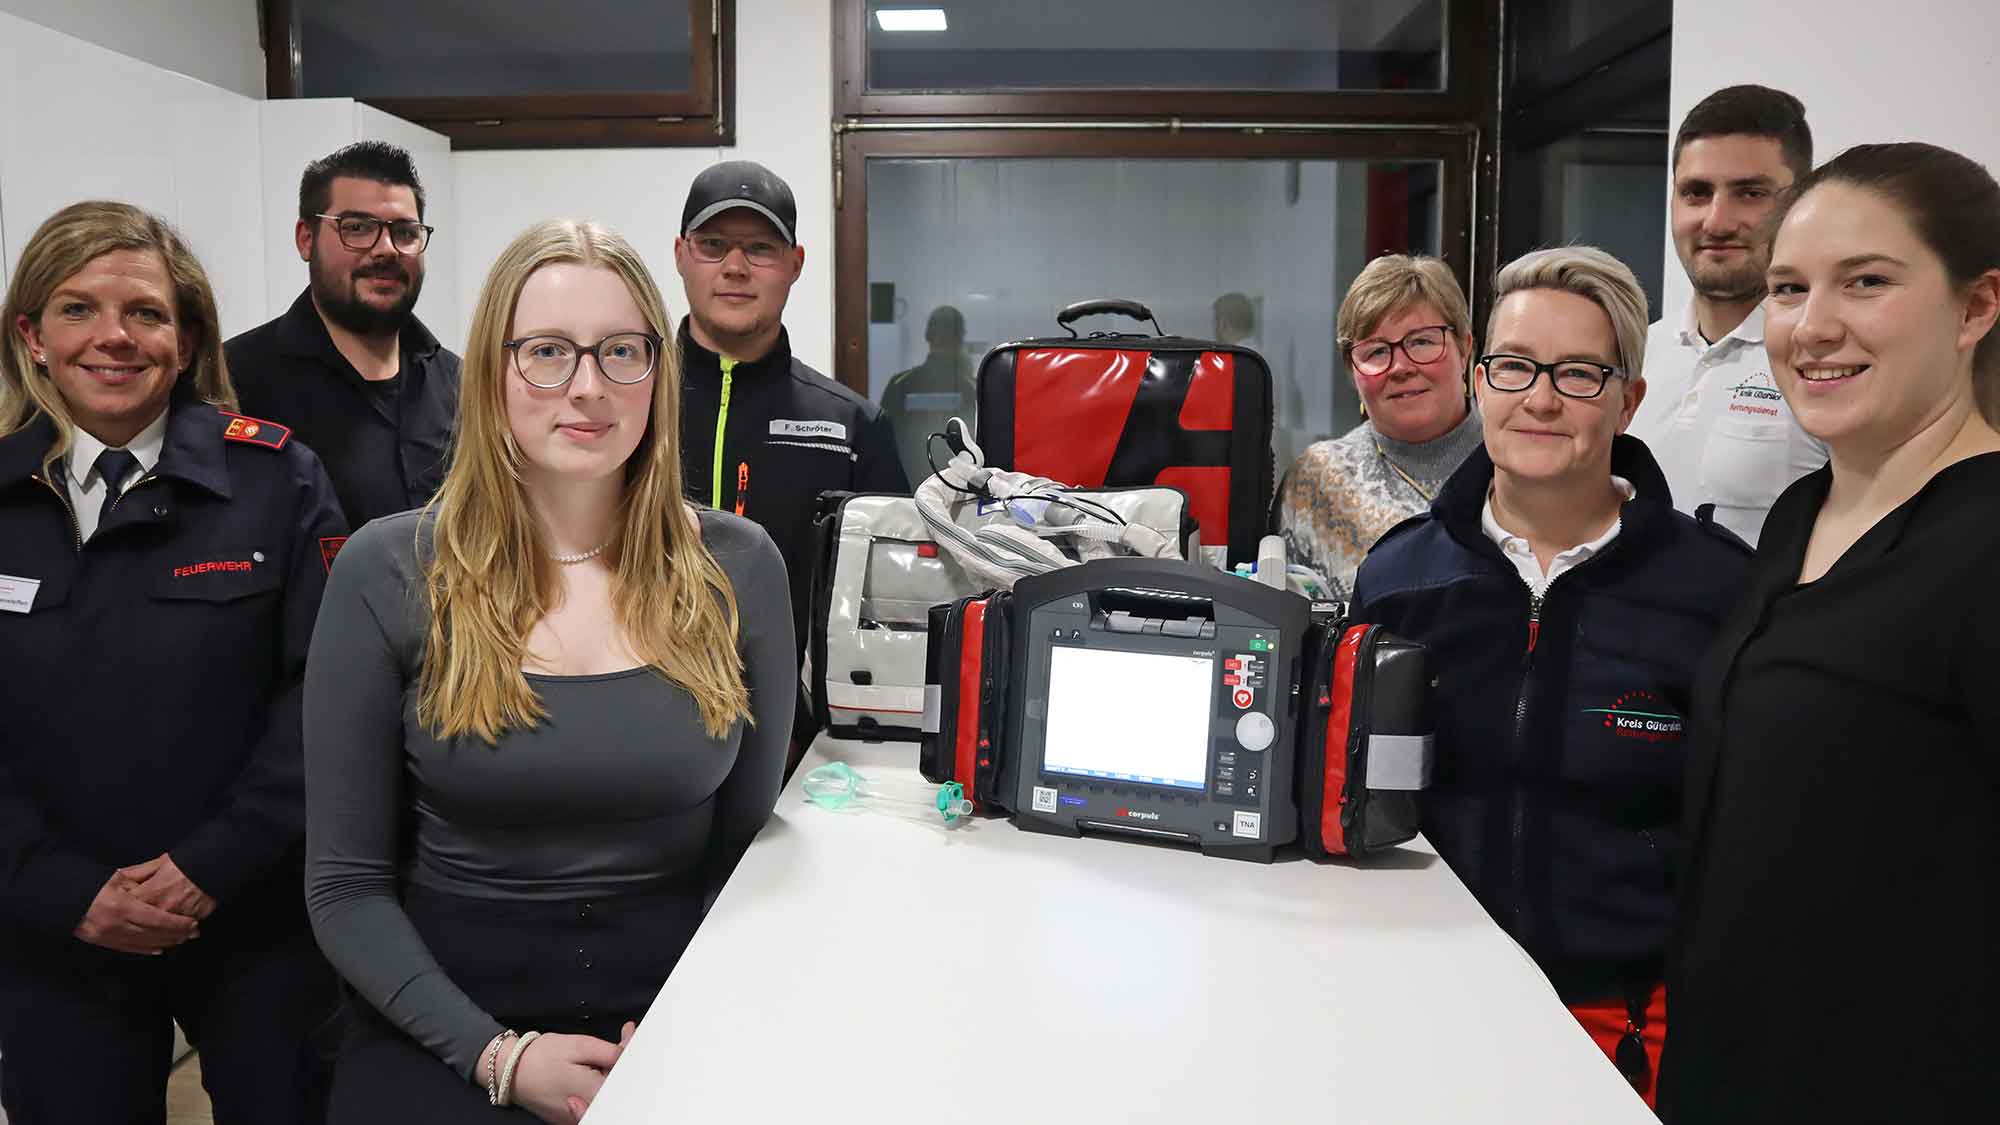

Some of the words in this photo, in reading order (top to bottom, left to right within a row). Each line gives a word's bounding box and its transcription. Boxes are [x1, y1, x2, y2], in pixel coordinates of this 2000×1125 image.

[795, 424, 833, 433] Schröter
[173, 561, 252, 577] FEUERWEHR
[1616, 717, 1643, 729] Kreis
[1128, 810, 1160, 821] corpuls
[1240, 820, 1256, 829] TNA
